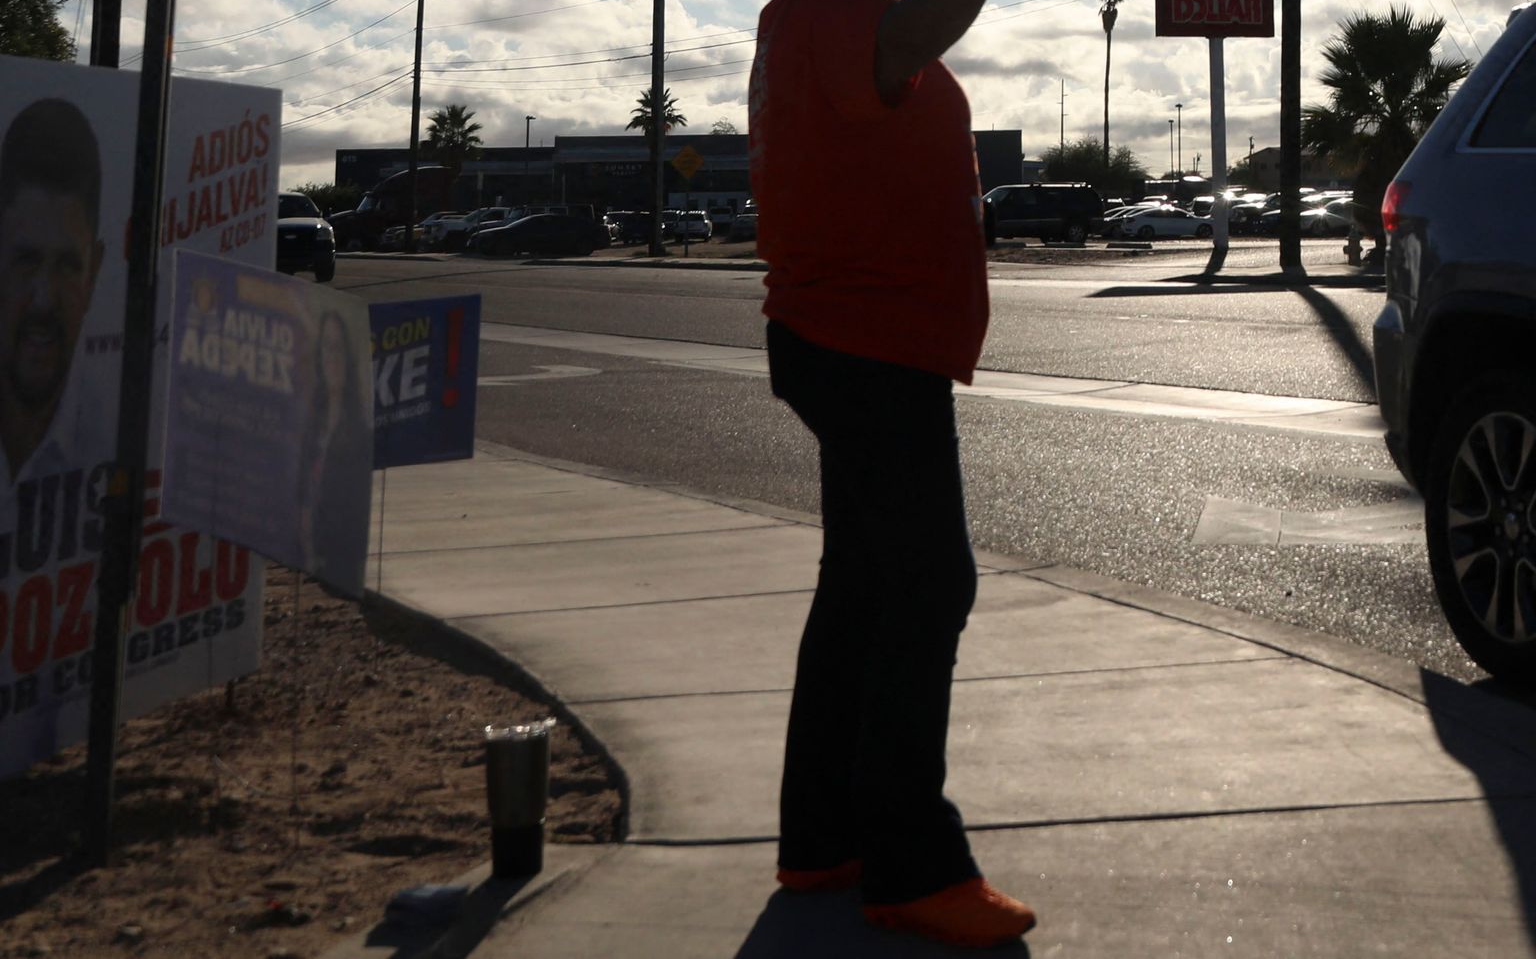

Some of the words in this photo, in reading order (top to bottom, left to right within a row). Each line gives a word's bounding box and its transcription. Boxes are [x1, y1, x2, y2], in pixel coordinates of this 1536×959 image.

[188, 108, 270, 183] ADIÓS
[124, 162, 268, 259] IJALVA!
[219, 225, 234, 253] AZ
[380, 316, 431, 350] CON
[0, 531, 248, 673] OZOLO
[52, 598, 245, 695] COGRESS
